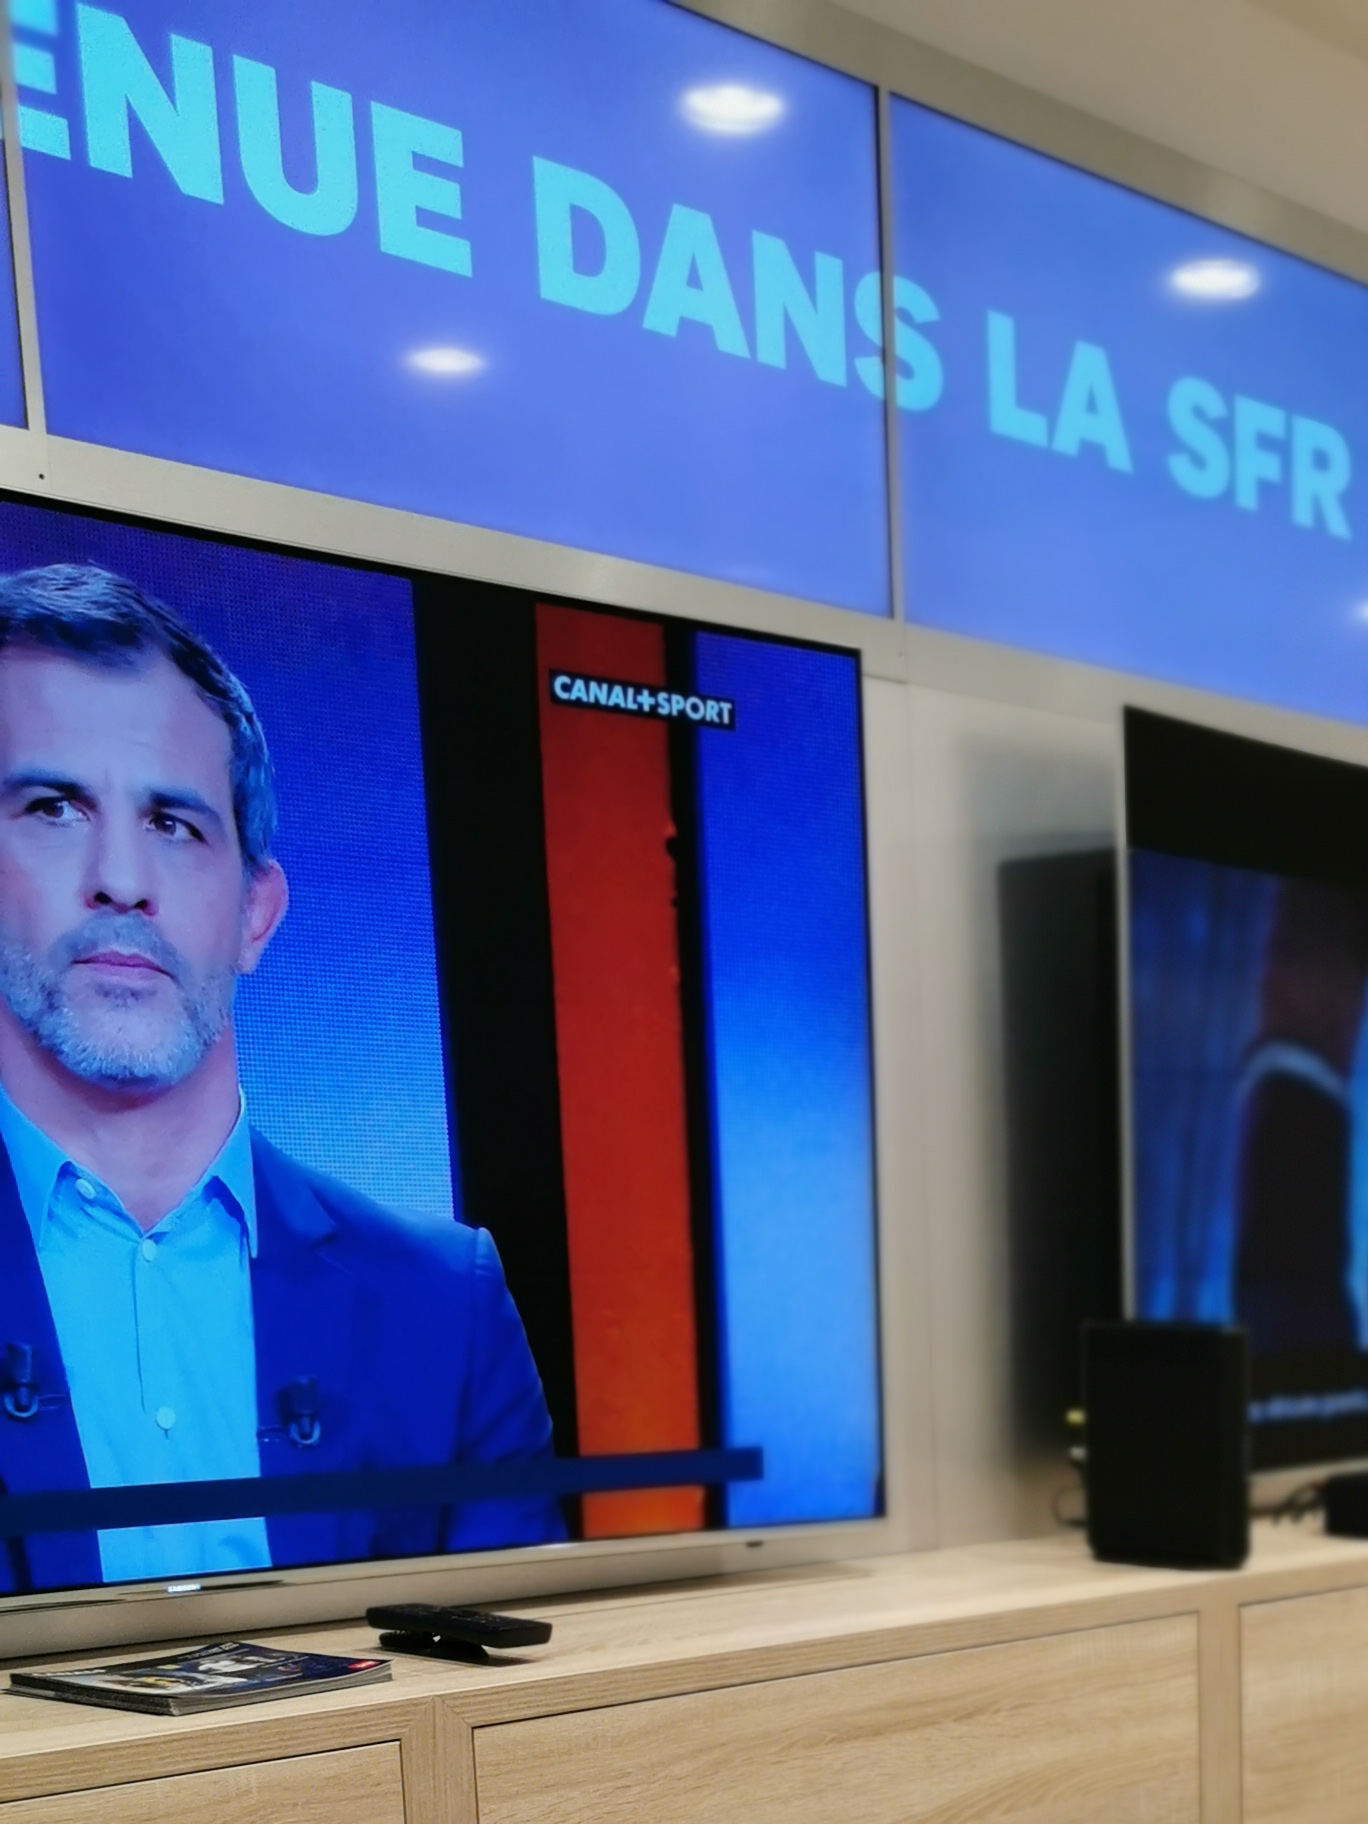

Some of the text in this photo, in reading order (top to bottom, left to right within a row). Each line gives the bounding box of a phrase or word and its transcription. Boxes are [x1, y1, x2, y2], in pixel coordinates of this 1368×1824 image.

[533, 155, 945, 411] DANS
[986, 309, 1133, 474] LA
[1166, 376, 1351, 540] SFR
